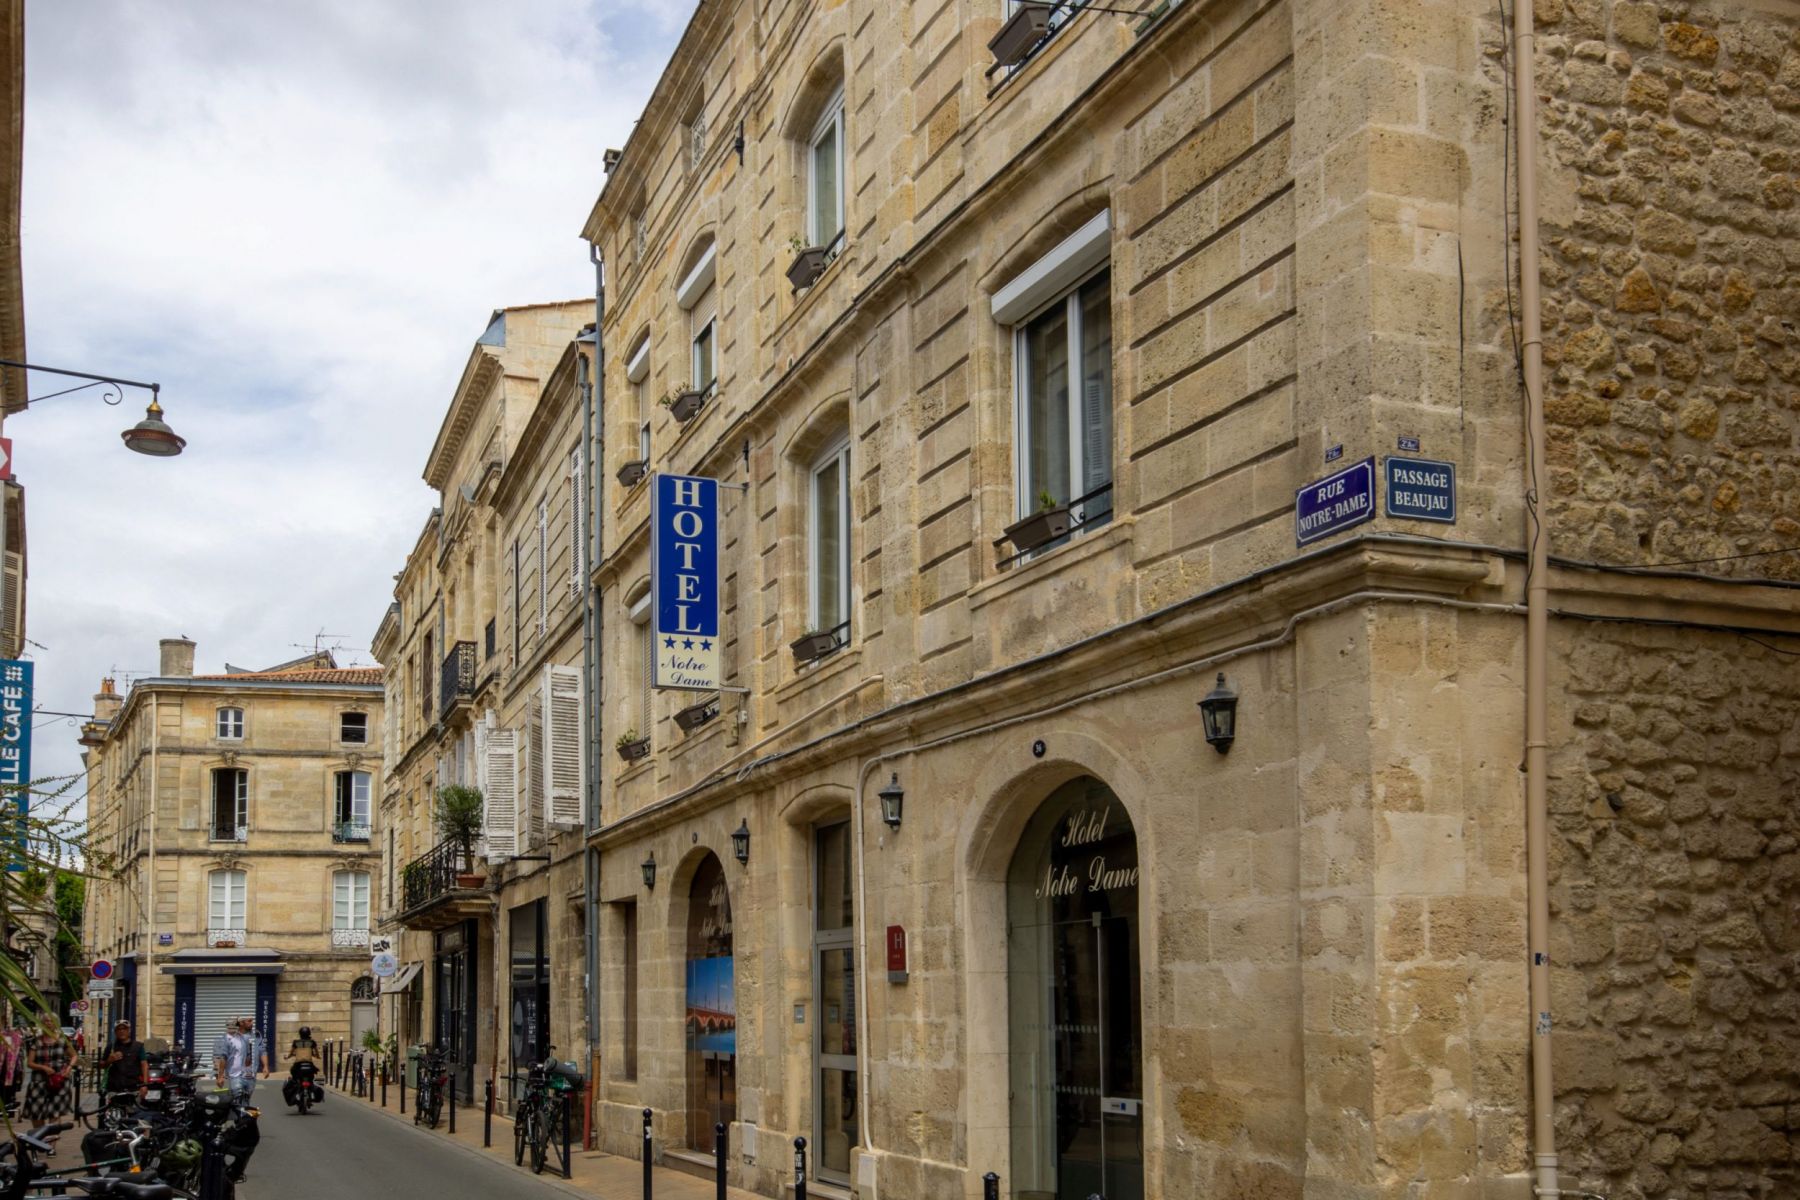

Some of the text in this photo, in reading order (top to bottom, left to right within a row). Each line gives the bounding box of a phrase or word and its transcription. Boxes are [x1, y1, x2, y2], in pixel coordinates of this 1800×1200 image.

[1317, 478, 1345, 504] RUE
[1393, 468, 1448, 488] PASSAGE
[1299, 492, 1368, 534] NOTRE-DAME
[1395, 490, 1449, 511] BEAUJAU
[672, 479, 703, 633] HOTEL
[661, 654, 708, 672] Notre
[670, 671, 714, 687] Dame
[1, 686, 22, 742] CAFÉ
[1062, 806, 1110, 847] Hotel
[1036, 856, 1139, 899] Notre Dame
[894, 932, 902, 950] H
